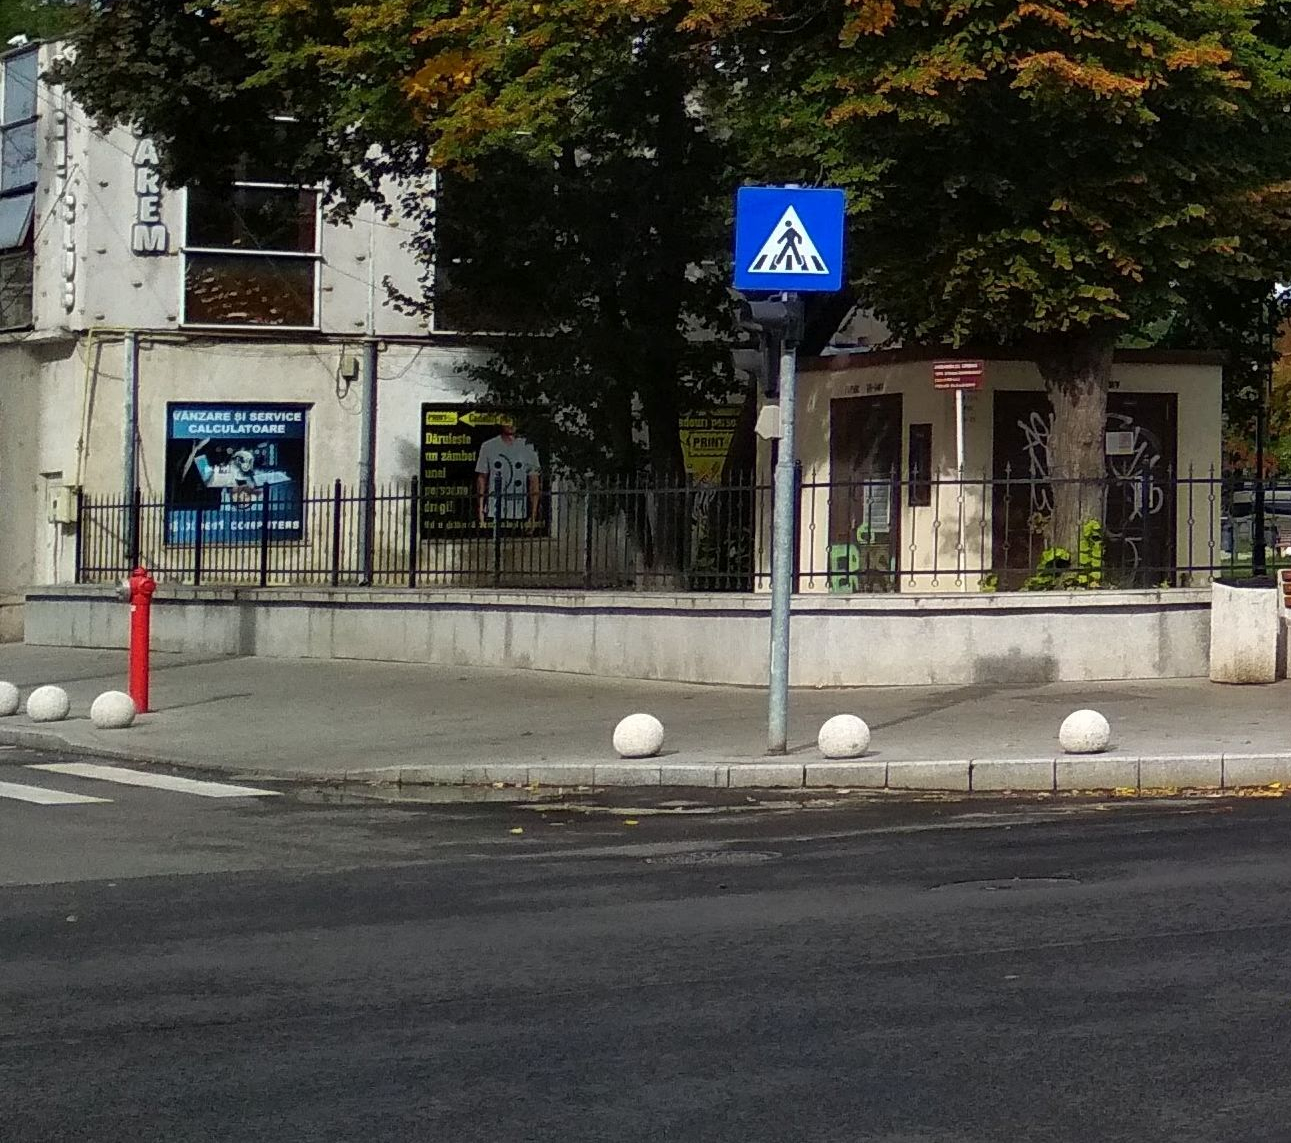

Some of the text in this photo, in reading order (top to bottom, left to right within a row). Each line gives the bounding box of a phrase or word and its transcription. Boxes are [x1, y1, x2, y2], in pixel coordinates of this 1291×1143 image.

[249, 411, 302, 422] SERVICE
[188, 424, 286, 434] CALCULATOARE
[693, 437, 725, 448] PRINT
